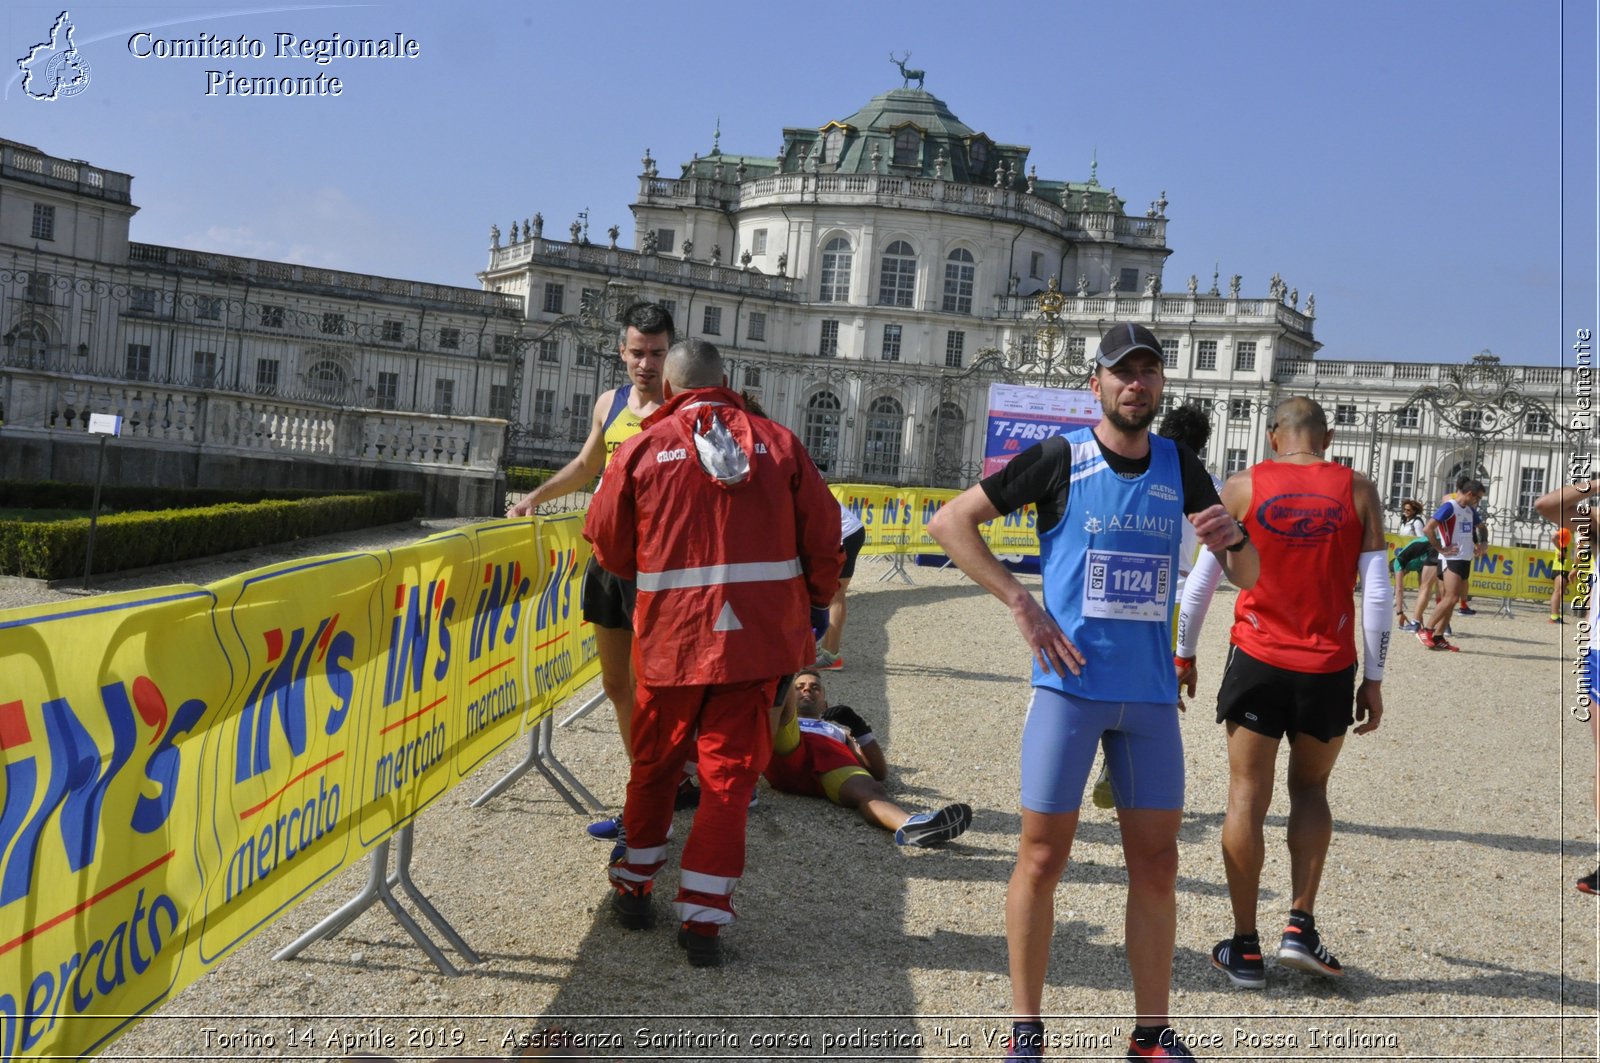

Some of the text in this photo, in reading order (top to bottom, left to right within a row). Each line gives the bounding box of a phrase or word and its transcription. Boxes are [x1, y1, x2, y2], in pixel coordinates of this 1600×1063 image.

[657, 448, 686, 463] CROCE
[882, 496, 912, 525] iN's
[1108, 514, 1175, 535] AZIMUT
[881, 532, 911, 545] mercato
[1003, 535, 1035, 547] mercato
[536, 548, 578, 632] iN's
[1112, 569, 1153, 593] 1124
[1472, 578, 1512, 593] mercato
[469, 561, 531, 663] iN's
[383, 579, 457, 708] iN's
[1377, 631, 1391, 668] saucony
[534, 649, 573, 697] mercato
[235, 612, 355, 785] iN's
[466, 675, 518, 740] mercato
[373, 719, 446, 802] mercato
[225, 774, 341, 904] mercato
